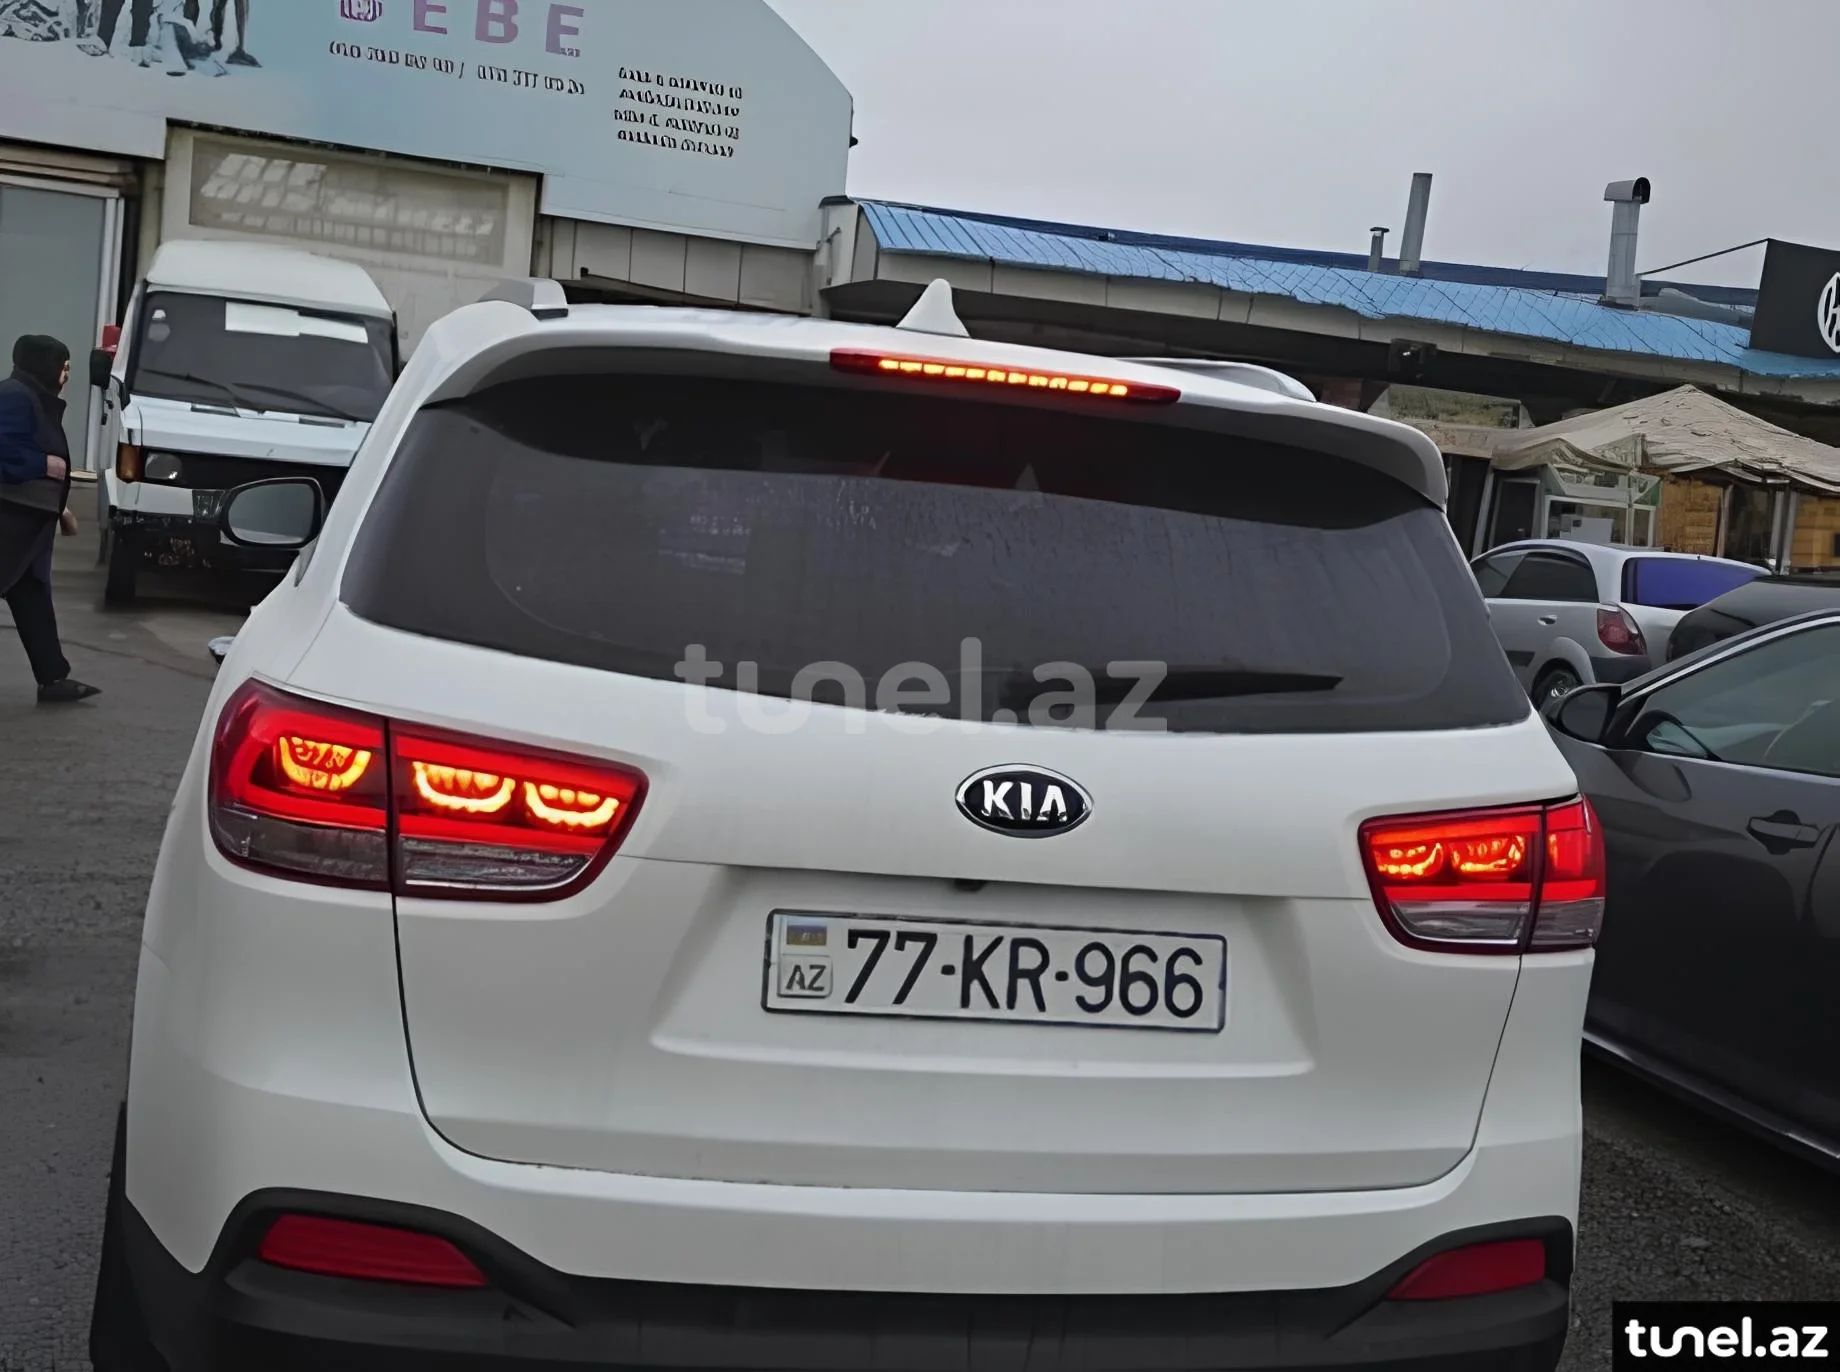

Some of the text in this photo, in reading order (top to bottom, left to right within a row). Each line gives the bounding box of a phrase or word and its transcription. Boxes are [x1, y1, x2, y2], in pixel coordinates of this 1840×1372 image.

[980, 780, 1069, 823] KIA
[785, 963, 826, 993] AZ
[844, 928, 1203, 1019] 77-KR-966
